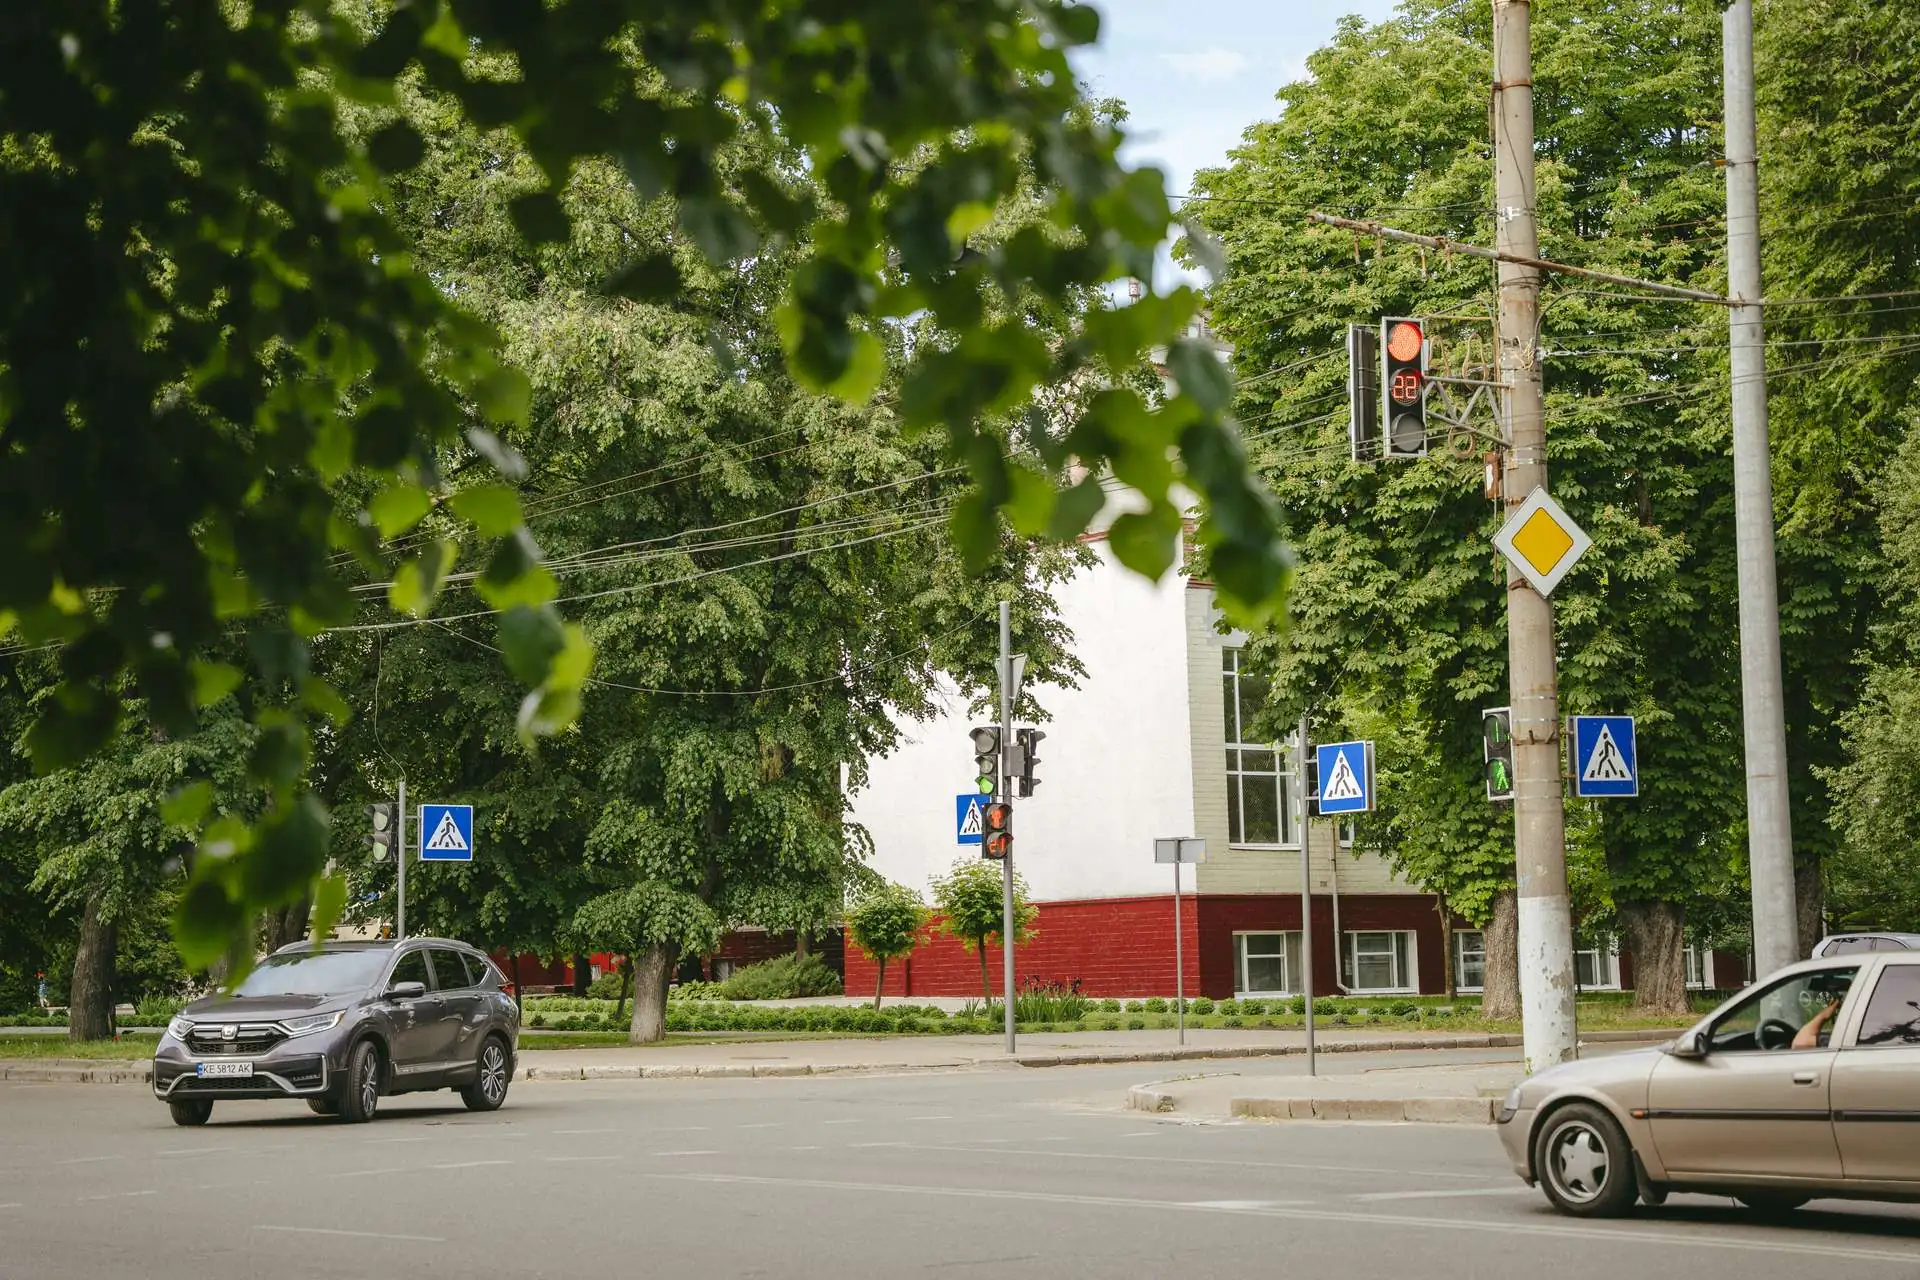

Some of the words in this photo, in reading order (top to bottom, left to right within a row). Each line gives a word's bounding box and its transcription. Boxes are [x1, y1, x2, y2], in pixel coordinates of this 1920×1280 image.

[1393, 375, 1417, 399] 22
[203, 1064, 214, 1073] KE
[217, 1064, 235, 1073] 5812
[238, 1064, 249, 1072] AK
